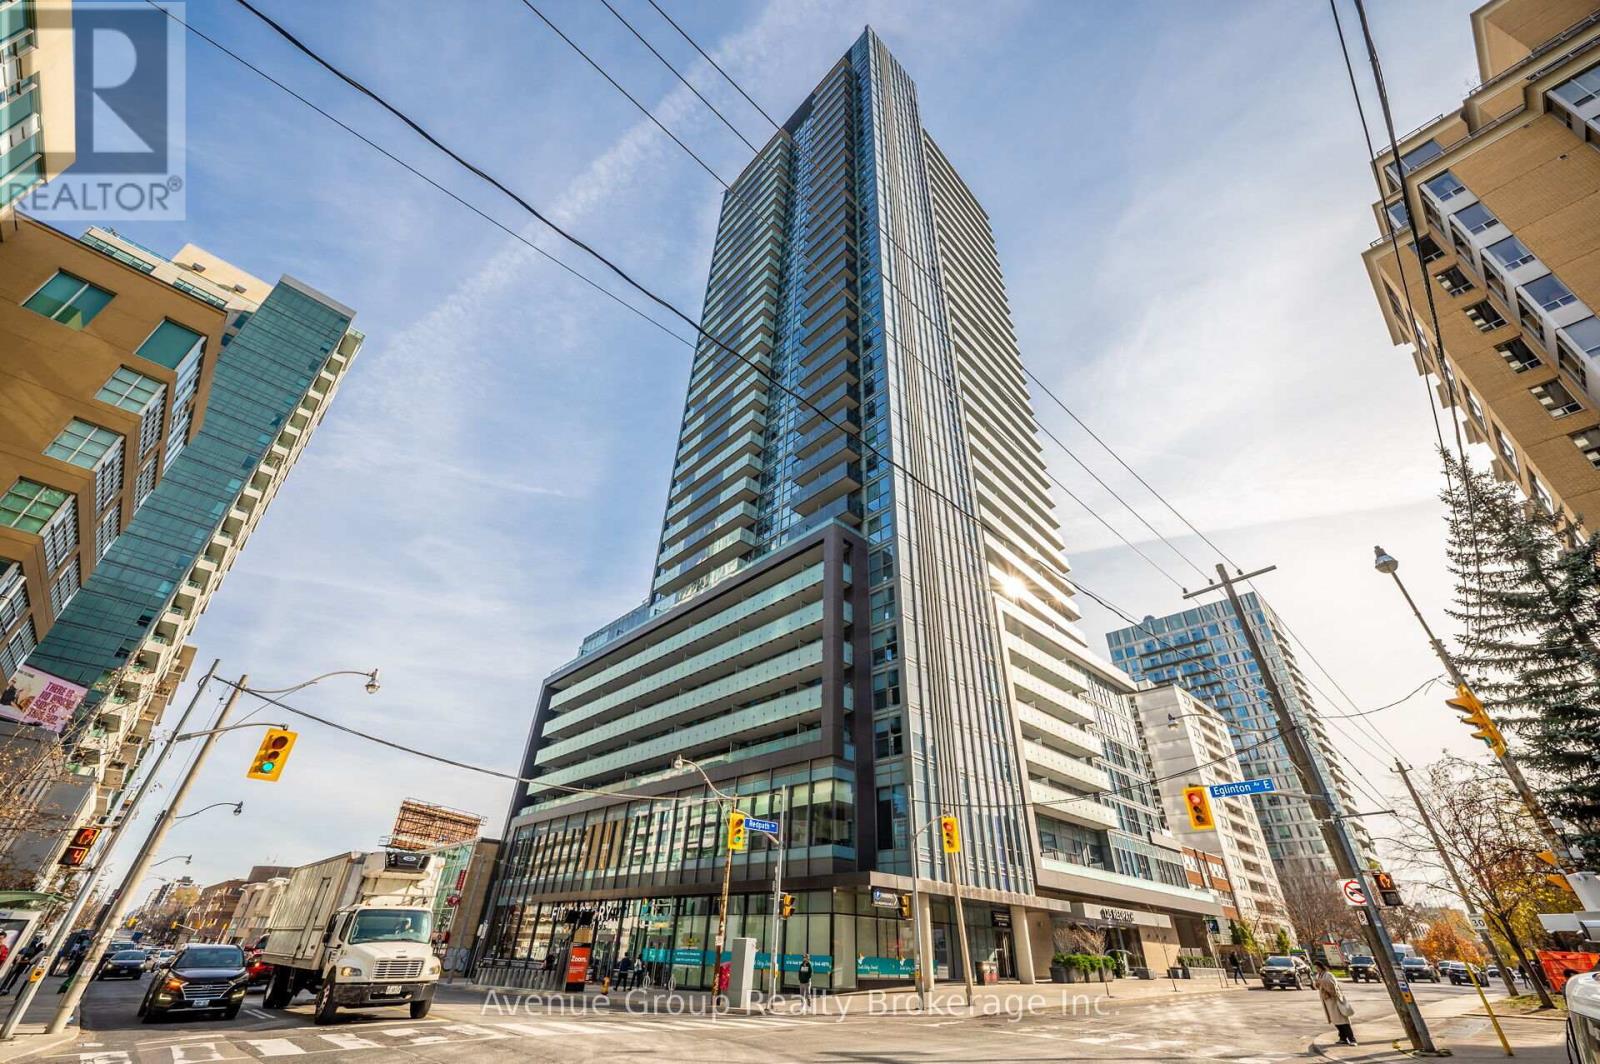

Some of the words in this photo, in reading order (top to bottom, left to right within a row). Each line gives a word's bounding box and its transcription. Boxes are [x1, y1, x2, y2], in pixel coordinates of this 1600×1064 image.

[46, 681, 67, 696] THERE
[1213, 784, 1251, 797] Eglinton
[1263, 780, 1270, 789] E
[748, 819, 770, 831] Redpath
